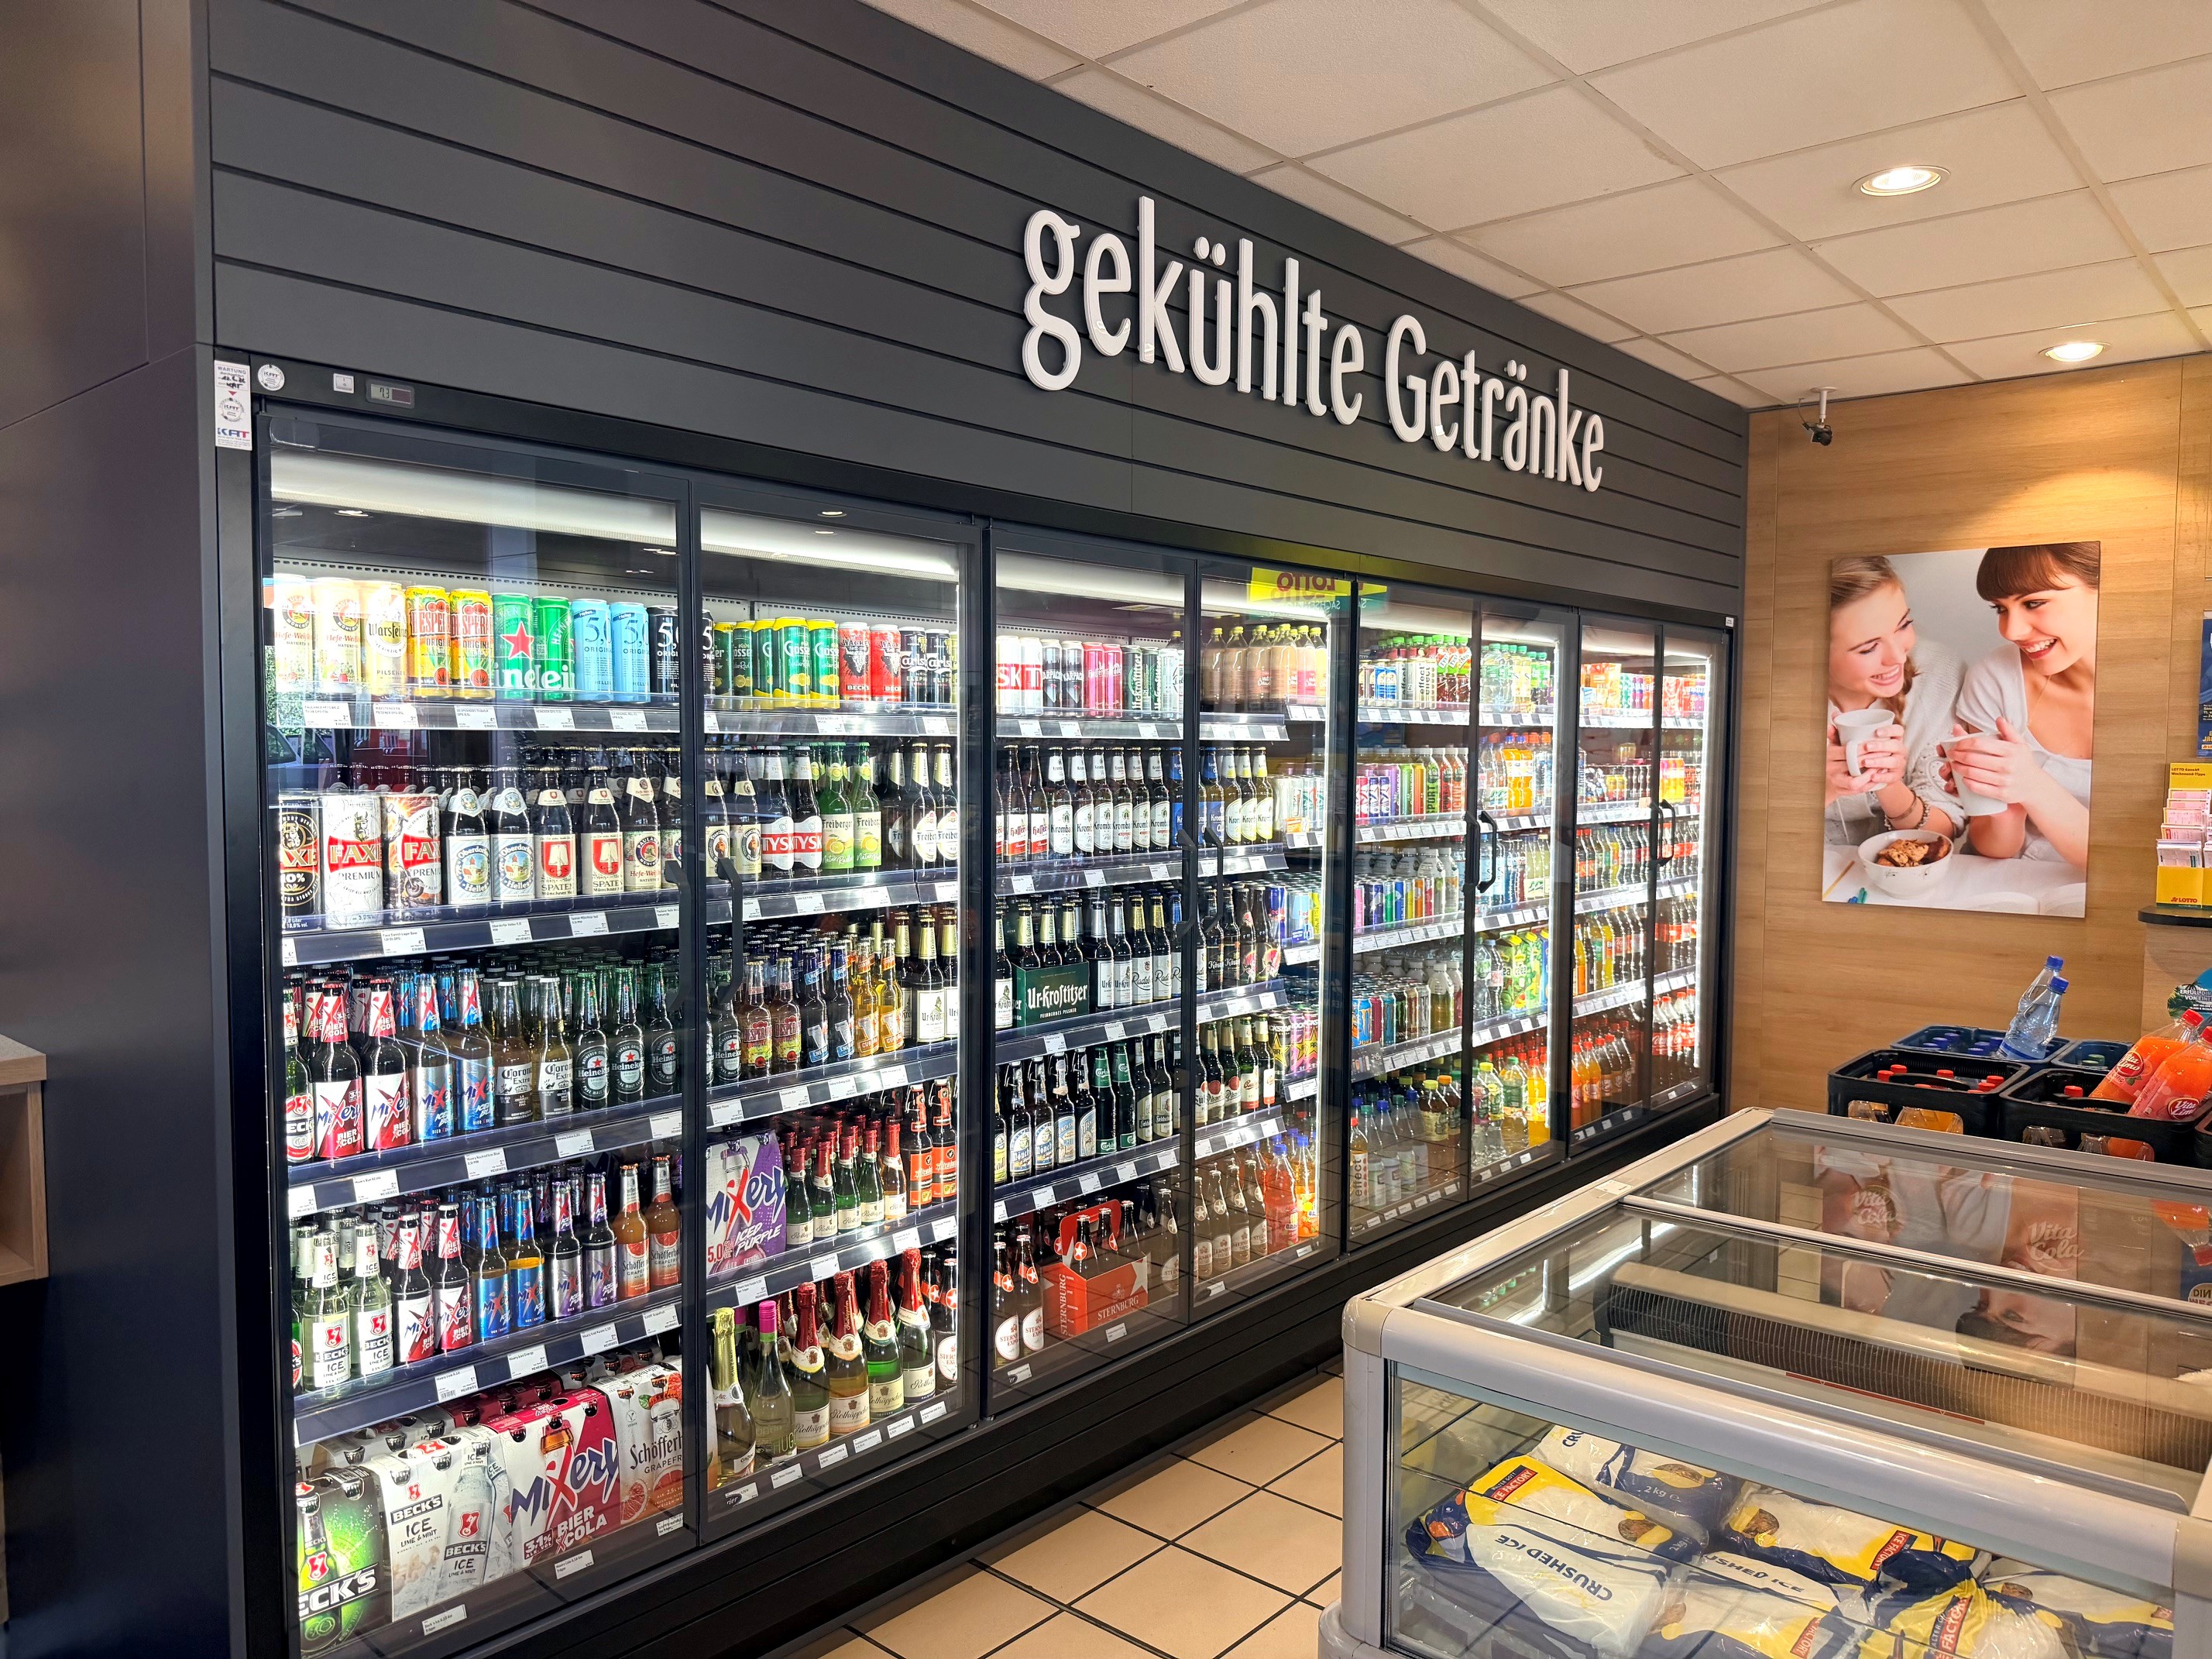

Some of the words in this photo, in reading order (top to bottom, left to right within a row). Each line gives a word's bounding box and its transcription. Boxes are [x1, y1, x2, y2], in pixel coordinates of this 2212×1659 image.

[1022, 196, 1365, 426] gekühlte
[1386, 314, 1605, 493] Getränke
[217, 366, 246, 375] WARTUNG
[329, 844, 383, 864] FAXE
[736, 1224, 782, 1258] PURPLE
[2028, 1221, 2076, 1243] Vita
[2030, 1238, 2084, 1261] Cola
[1097, 1295, 1139, 1321] STERNBURG
[373, 1349, 389, 1359] ICE
[327, 1362, 345, 1372] ICE
[1503, 1469, 1533, 1494] FACTORY
[1652, 1487, 1667, 1498] kg
[392, 1496, 442, 1523] BECK'S
[406, 1517, 431, 1537] ICE
[557, 1506, 595, 1537] BIER
[400, 1534, 416, 1547] LIME
[565, 1516, 607, 1548] COLA
[1894, 1532, 1908, 1545] ICE
[445, 1542, 486, 1560] BECK'S
[1495, 1534, 1523, 1551] ICE
[454, 1558, 474, 1569] ICE
[1527, 1547, 1613, 1602] CRUSHED
[1771, 1578, 1805, 1593] ICE
